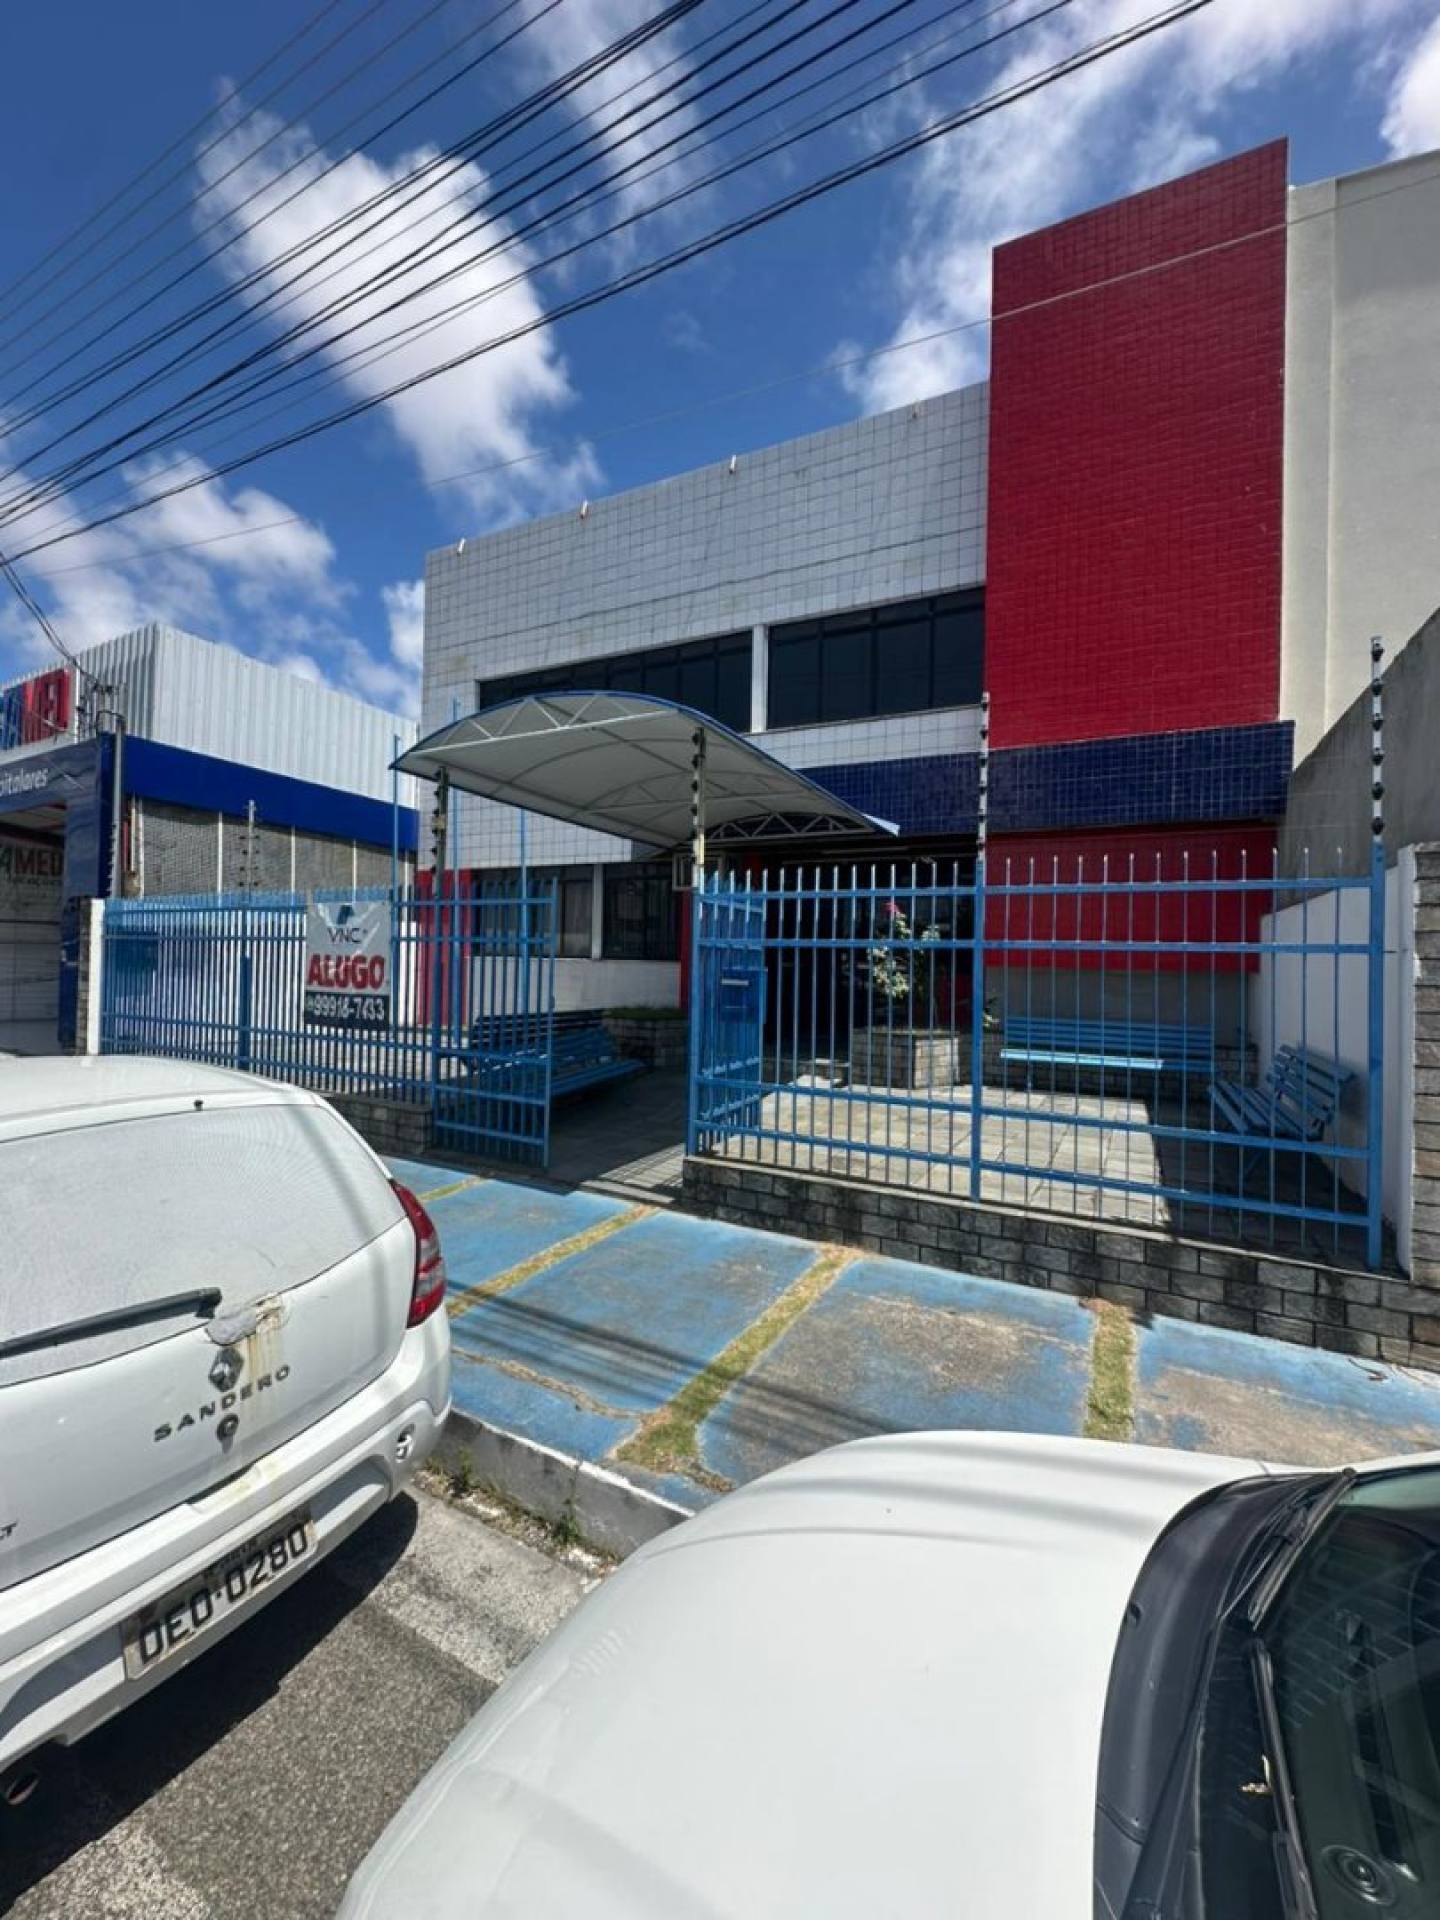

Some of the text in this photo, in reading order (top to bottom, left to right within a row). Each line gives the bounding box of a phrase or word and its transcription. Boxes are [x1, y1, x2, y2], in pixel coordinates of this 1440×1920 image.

[327, 926, 362, 944] VNC
[308, 954, 385, 990] ALUGO
[153, 1364, 290, 1443] SANDERO
